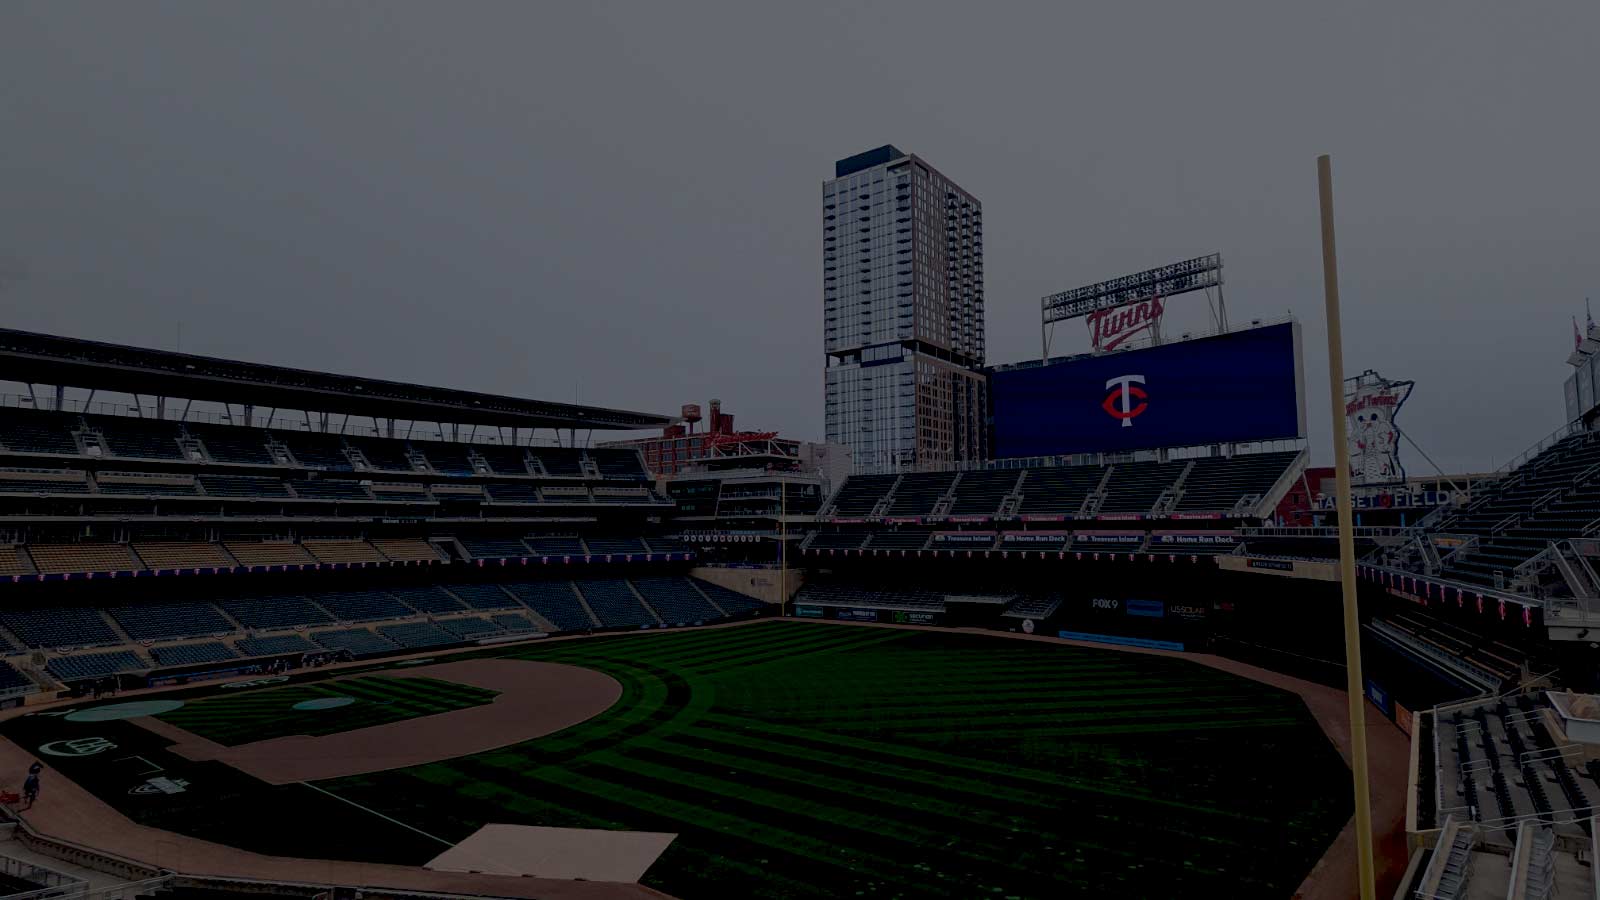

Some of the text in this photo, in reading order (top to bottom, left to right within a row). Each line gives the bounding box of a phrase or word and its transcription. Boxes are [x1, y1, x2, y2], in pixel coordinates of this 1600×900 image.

[1087, 294, 1164, 351] Twins
[1317, 491, 1450, 509] TAGET FIELD
[1177, 535, 1234, 544] Home Run Deck
[1092, 599, 1119, 609] FOX 9
